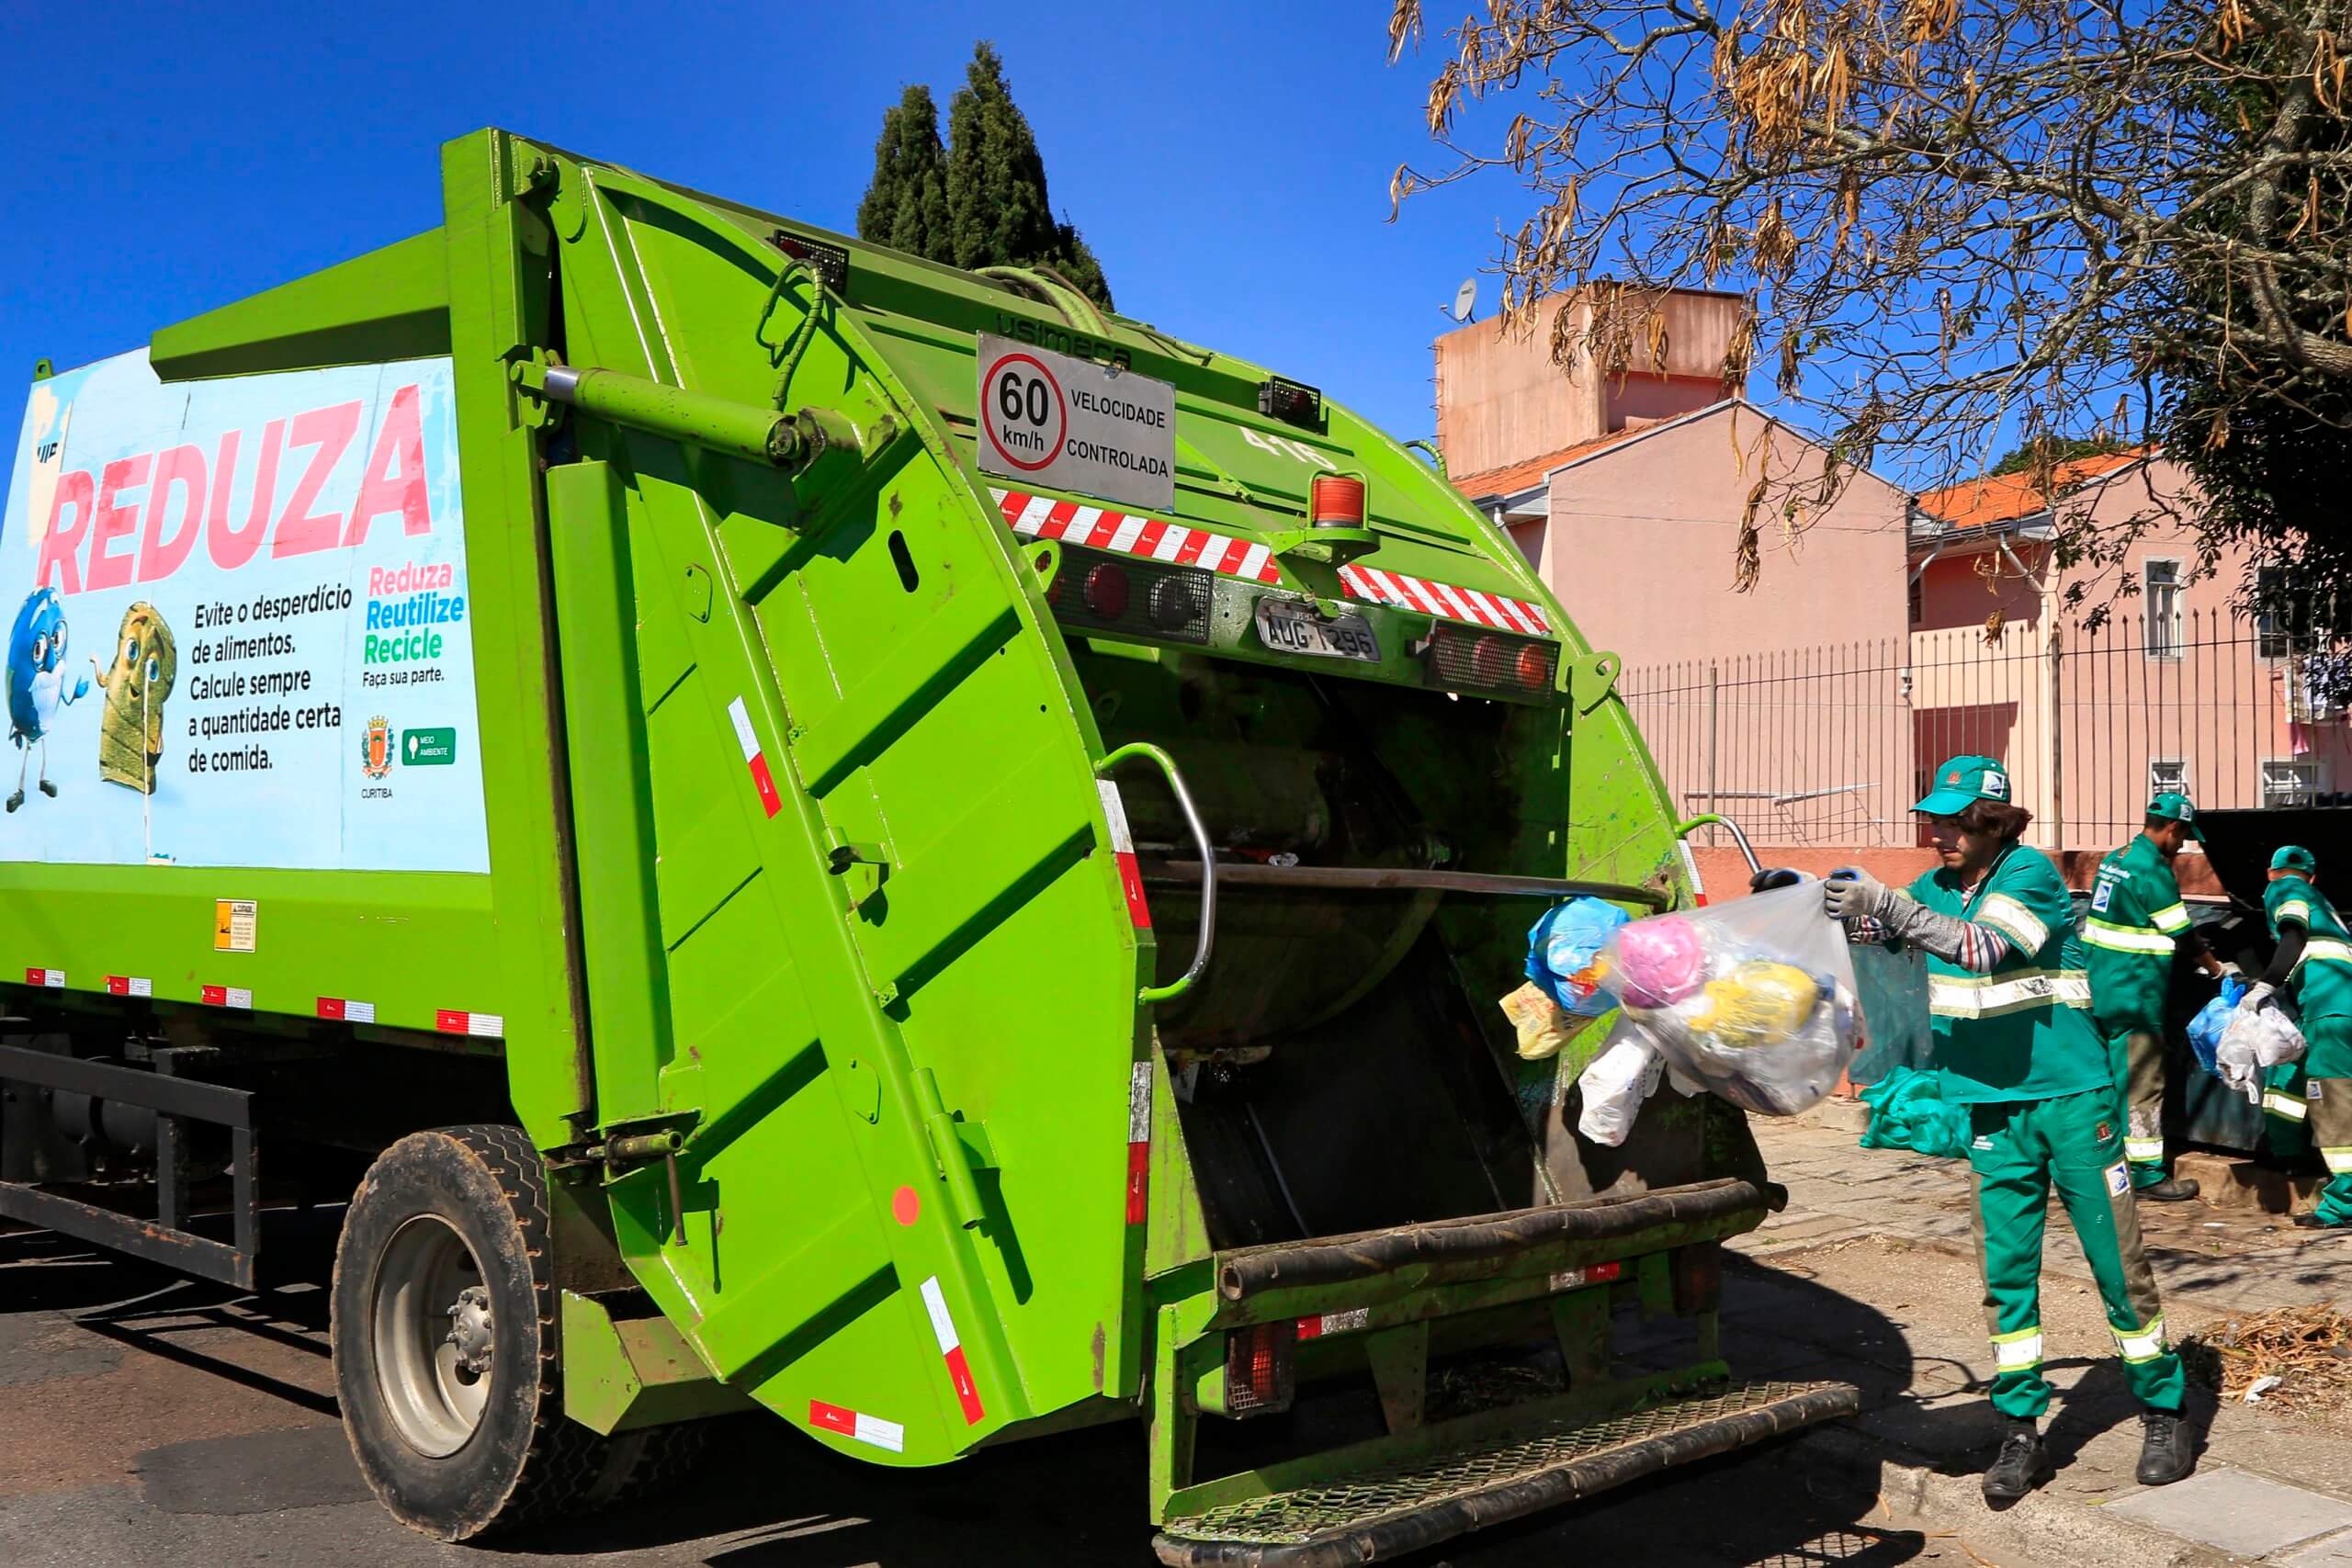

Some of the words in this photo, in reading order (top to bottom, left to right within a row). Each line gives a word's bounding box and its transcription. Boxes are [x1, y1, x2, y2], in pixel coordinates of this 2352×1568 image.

[999, 371, 1049, 426] 60
[1070, 389, 1166, 428] VELOCIDADE
[1002, 424, 1044, 451] km/h
[1067, 438, 1169, 478] CONTROLADA
[35, 384, 432, 596] REDUZA
[368, 561, 452, 597] Reduza
[194, 602, 233, 629] Evite
[238, 603, 248, 623] o
[253, 582, 352, 622] desperdício
[366, 592, 464, 631] Reutilize
[192, 639, 210, 664] de
[215, 632, 296, 662] alimentos.
[364, 627, 442, 664] Recicle
[190, 671, 245, 700] Calcule
[249, 669, 311, 697] sempre
[363, 671, 387, 689] Faça
[390, 671, 408, 684] sua
[411, 666, 445, 686] parte.
[188, 717, 197, 736] a
[201, 705, 290, 740] quantidade
[296, 703, 341, 729] certa
[188, 748, 207, 773] de
[211, 744, 273, 772] comida.
[361, 788, 393, 799] CURITIBA
